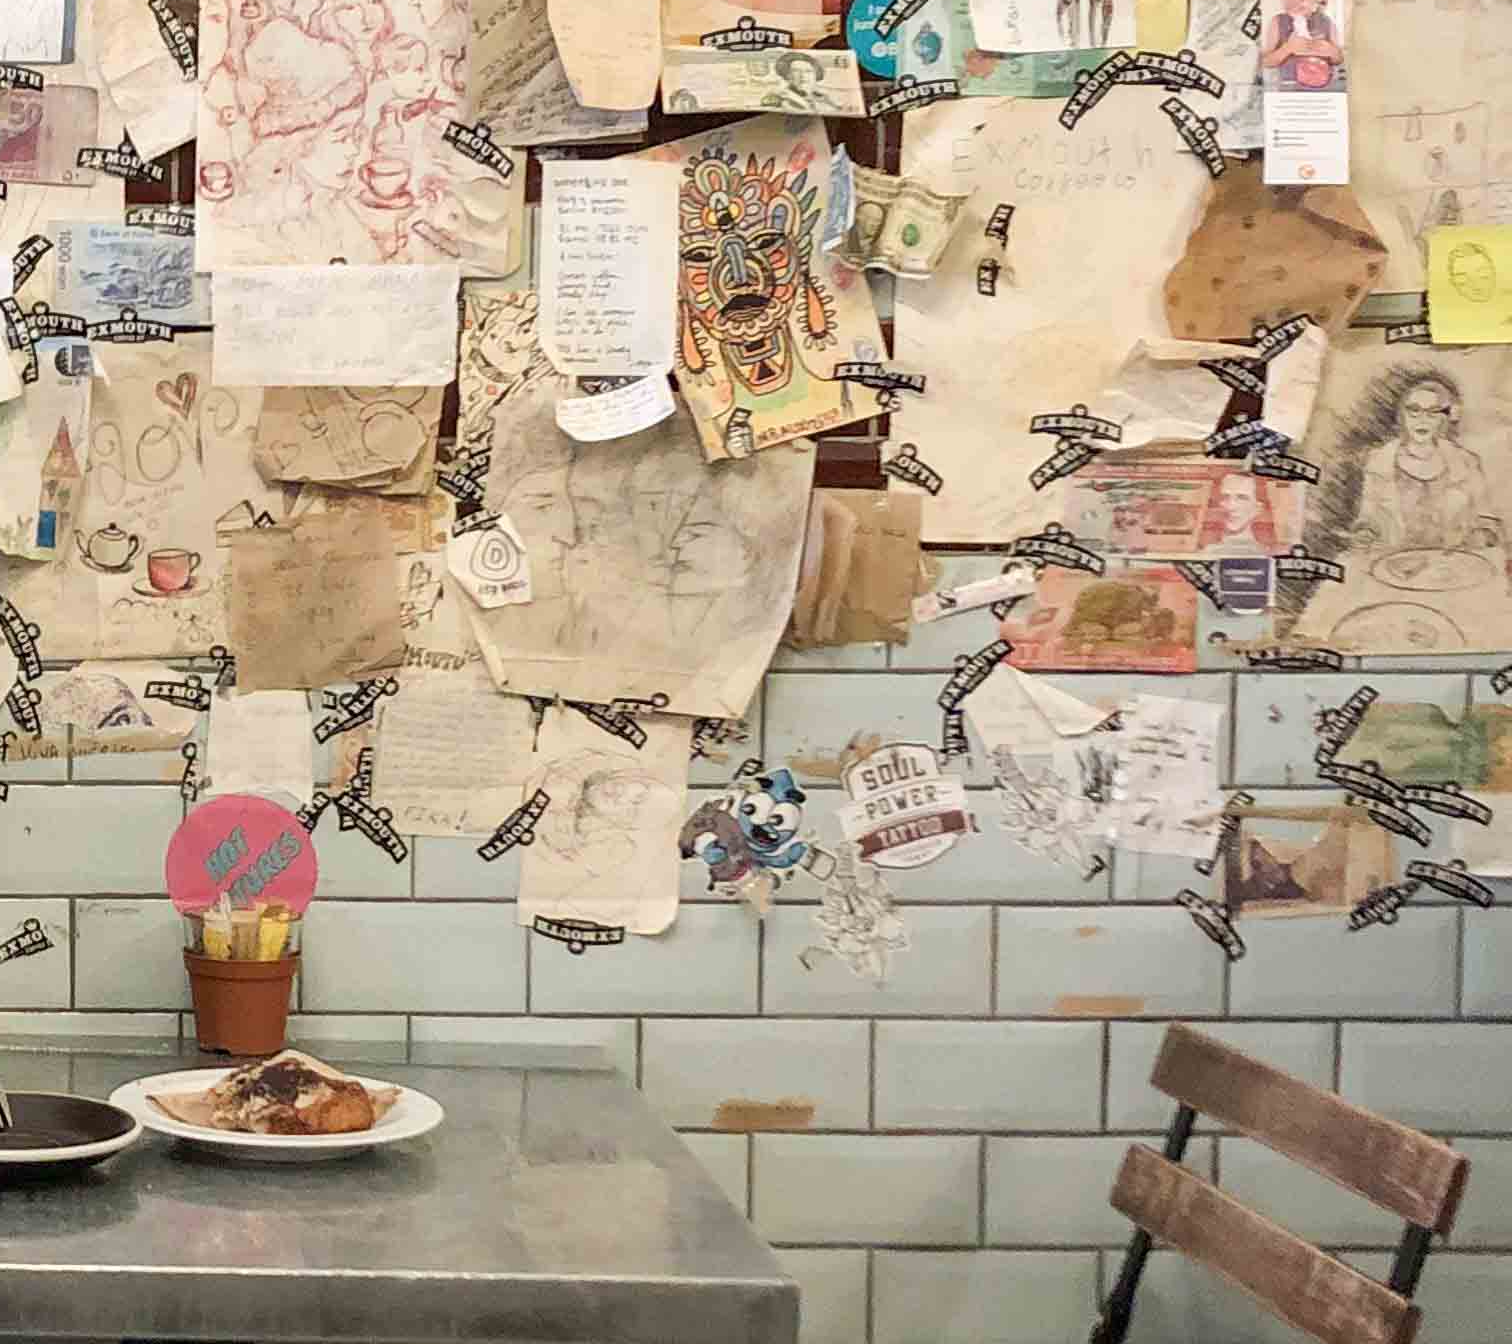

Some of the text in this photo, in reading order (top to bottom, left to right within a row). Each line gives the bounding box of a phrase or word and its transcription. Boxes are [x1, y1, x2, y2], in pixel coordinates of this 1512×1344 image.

[700, 29, 792, 50] EXMOUTH
[90, 319, 174, 341] EXMOUTH
[861, 754, 926, 792] SOUL
[864, 785, 938, 821] POWER
